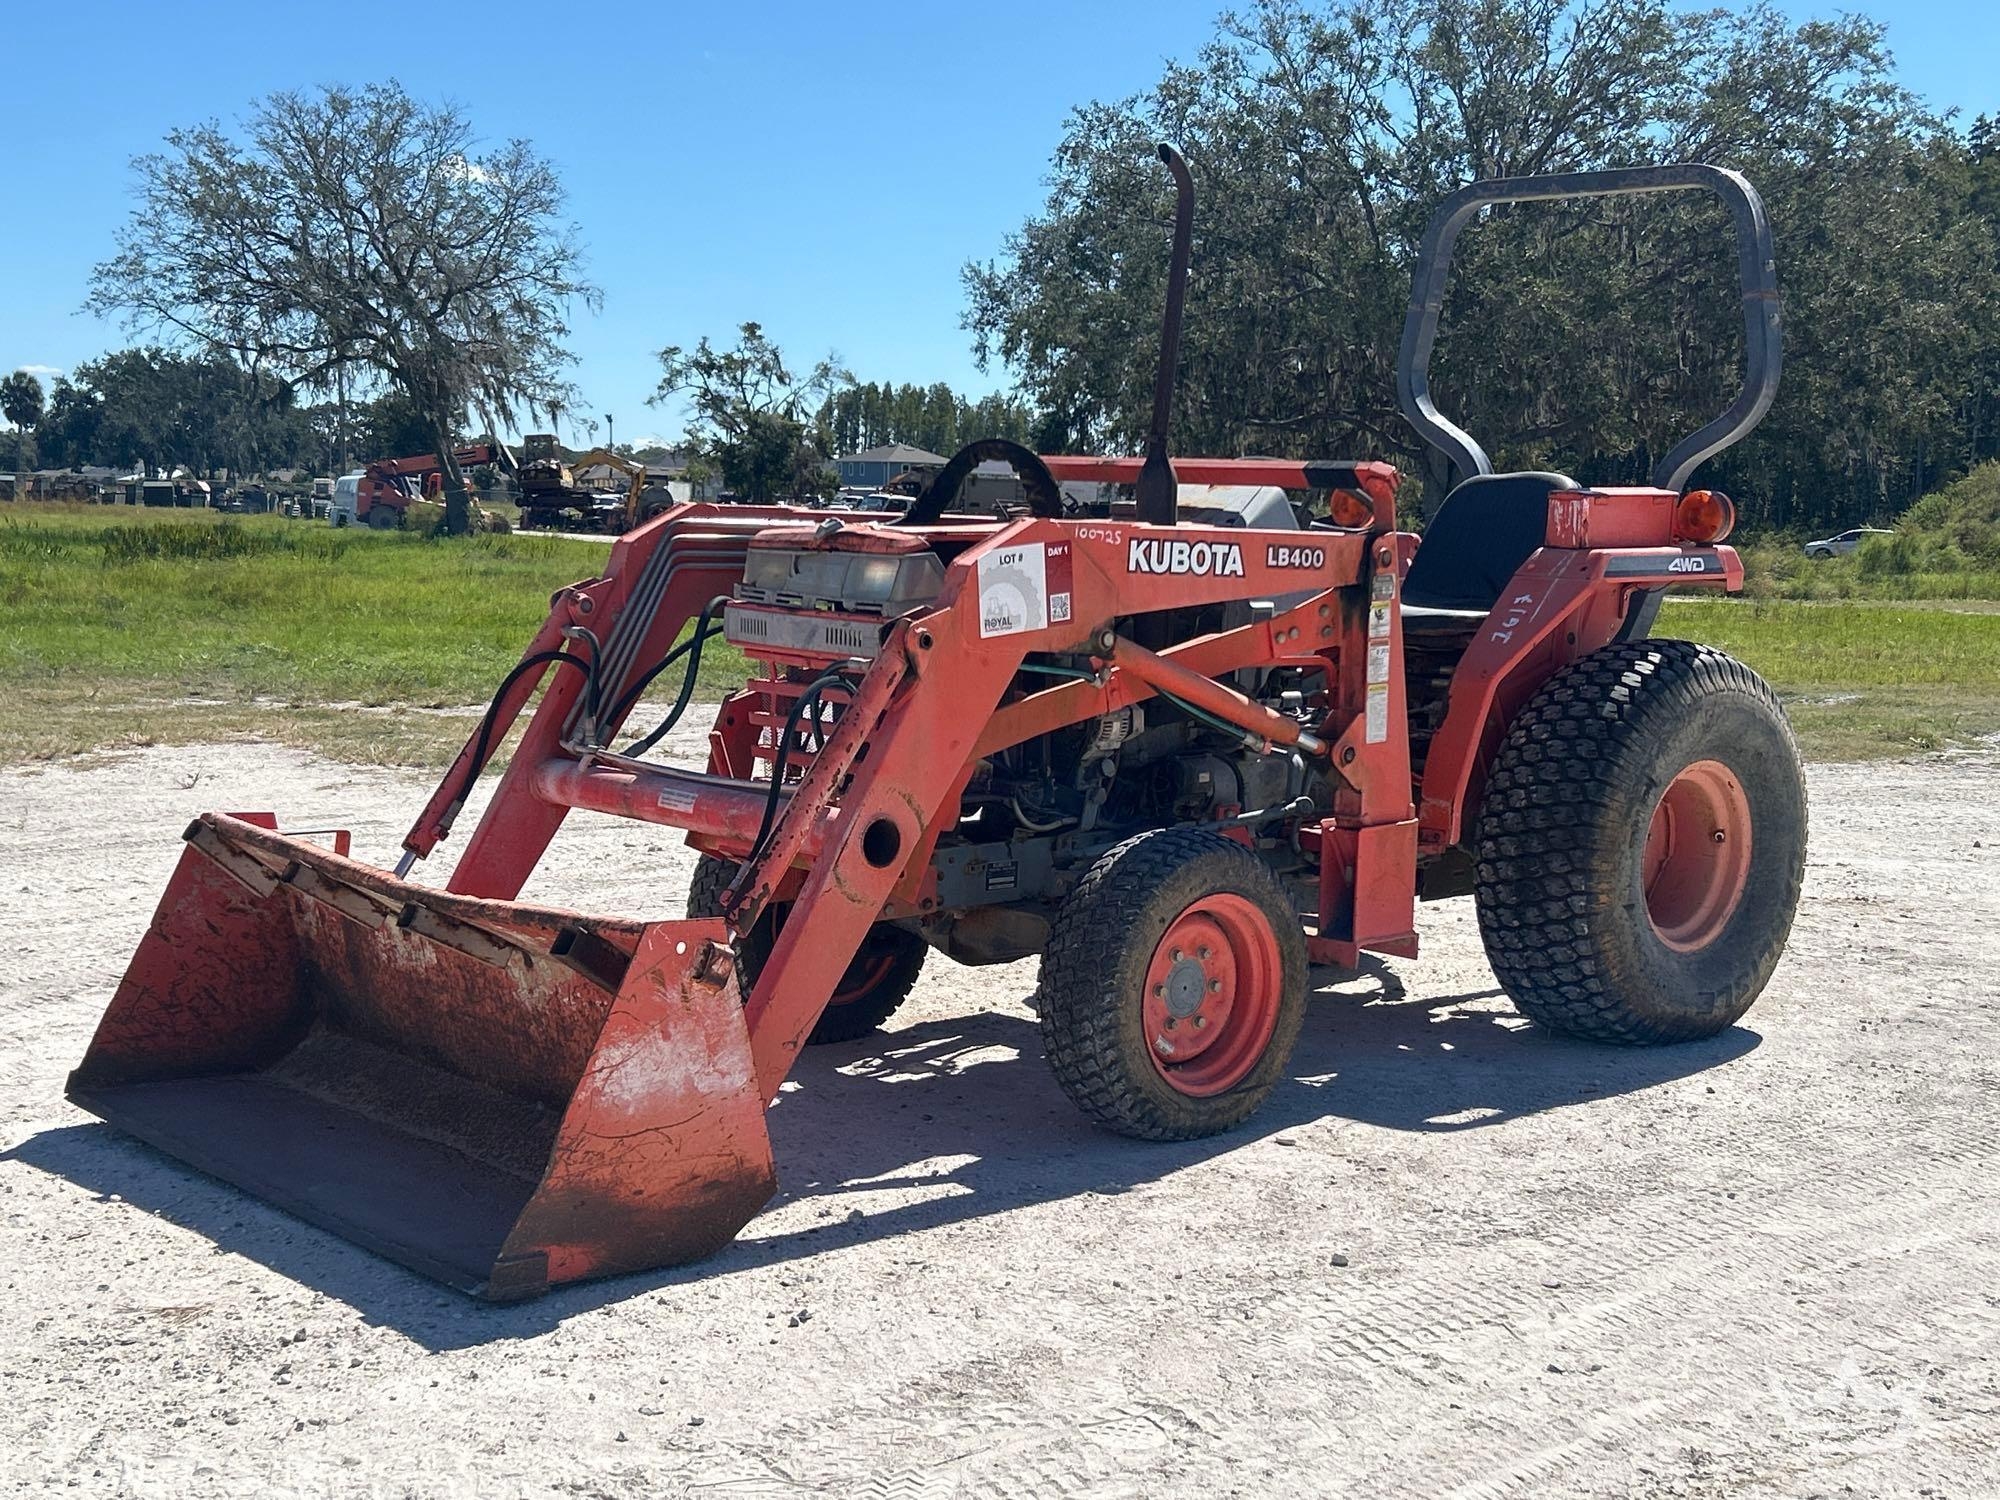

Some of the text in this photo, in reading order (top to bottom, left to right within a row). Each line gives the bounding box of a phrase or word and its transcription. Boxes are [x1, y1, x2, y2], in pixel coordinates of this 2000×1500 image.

[1075, 525, 1121, 545] 100725
[999, 554, 1016, 565] LOT
[1048, 547, 1062, 557] DAY
[1128, 539, 1244, 576] KUBOTA
[1267, 547, 1324, 568] LB400
[1668, 557, 1705, 572] 4WD
[984, 616, 1012, 629] ROYAL
